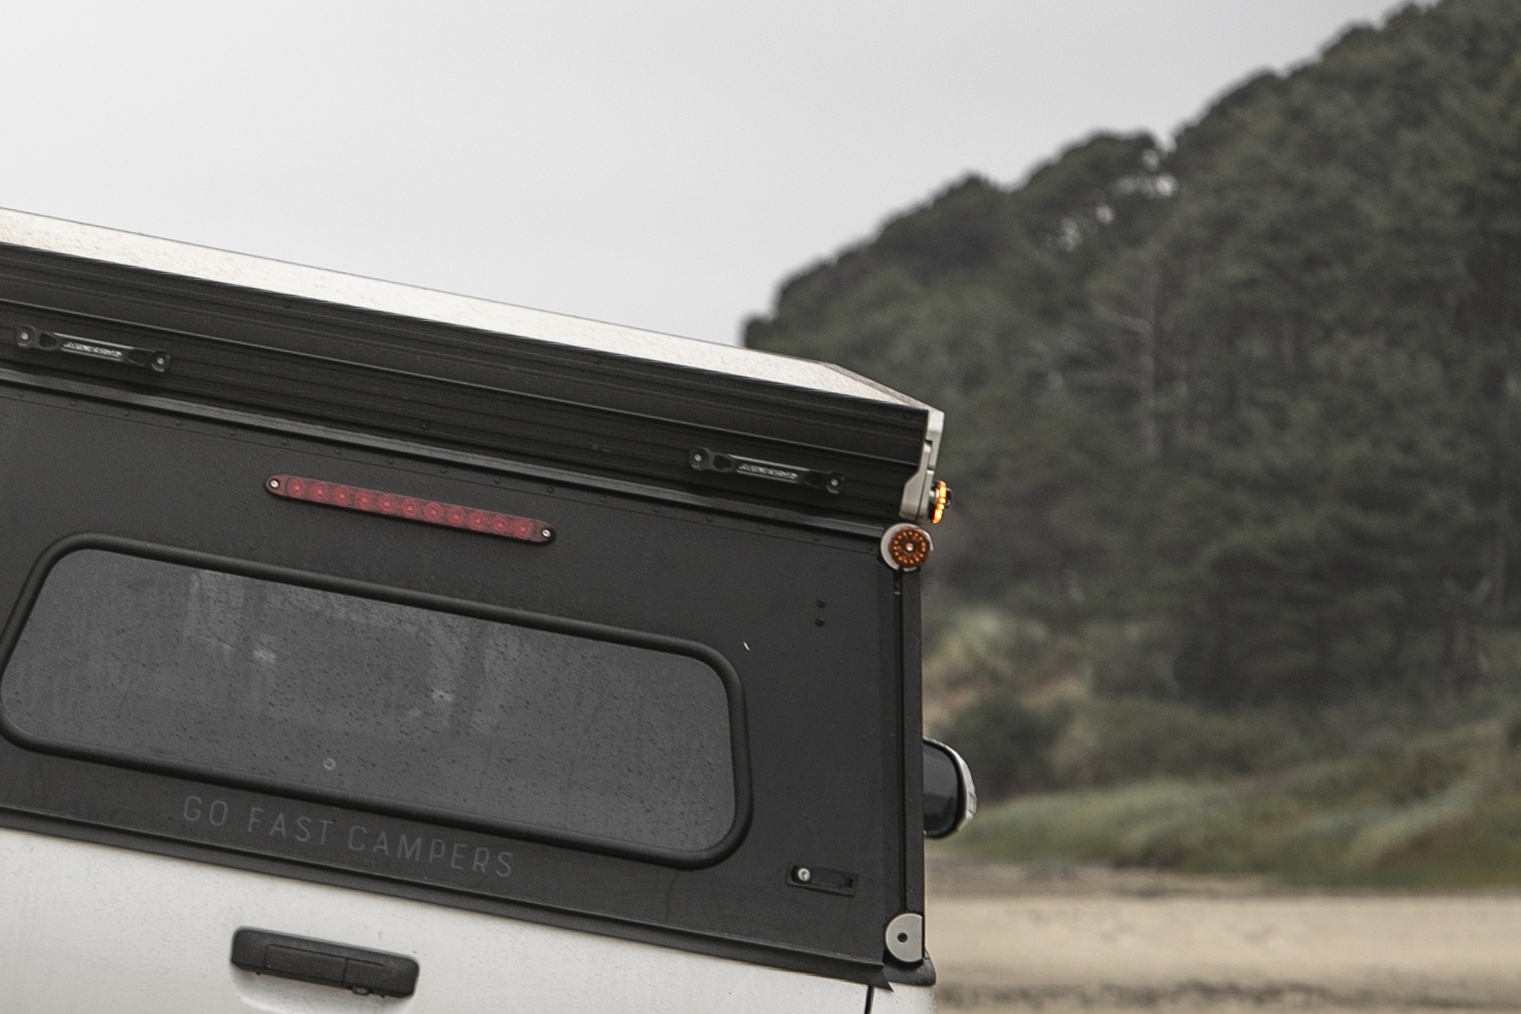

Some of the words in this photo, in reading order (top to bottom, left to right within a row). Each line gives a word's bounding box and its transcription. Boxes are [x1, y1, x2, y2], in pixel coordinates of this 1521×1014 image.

[182, 795, 229, 827] GO
[246, 806, 336, 846] FAST
[347, 824, 515, 878] CAMPERS
